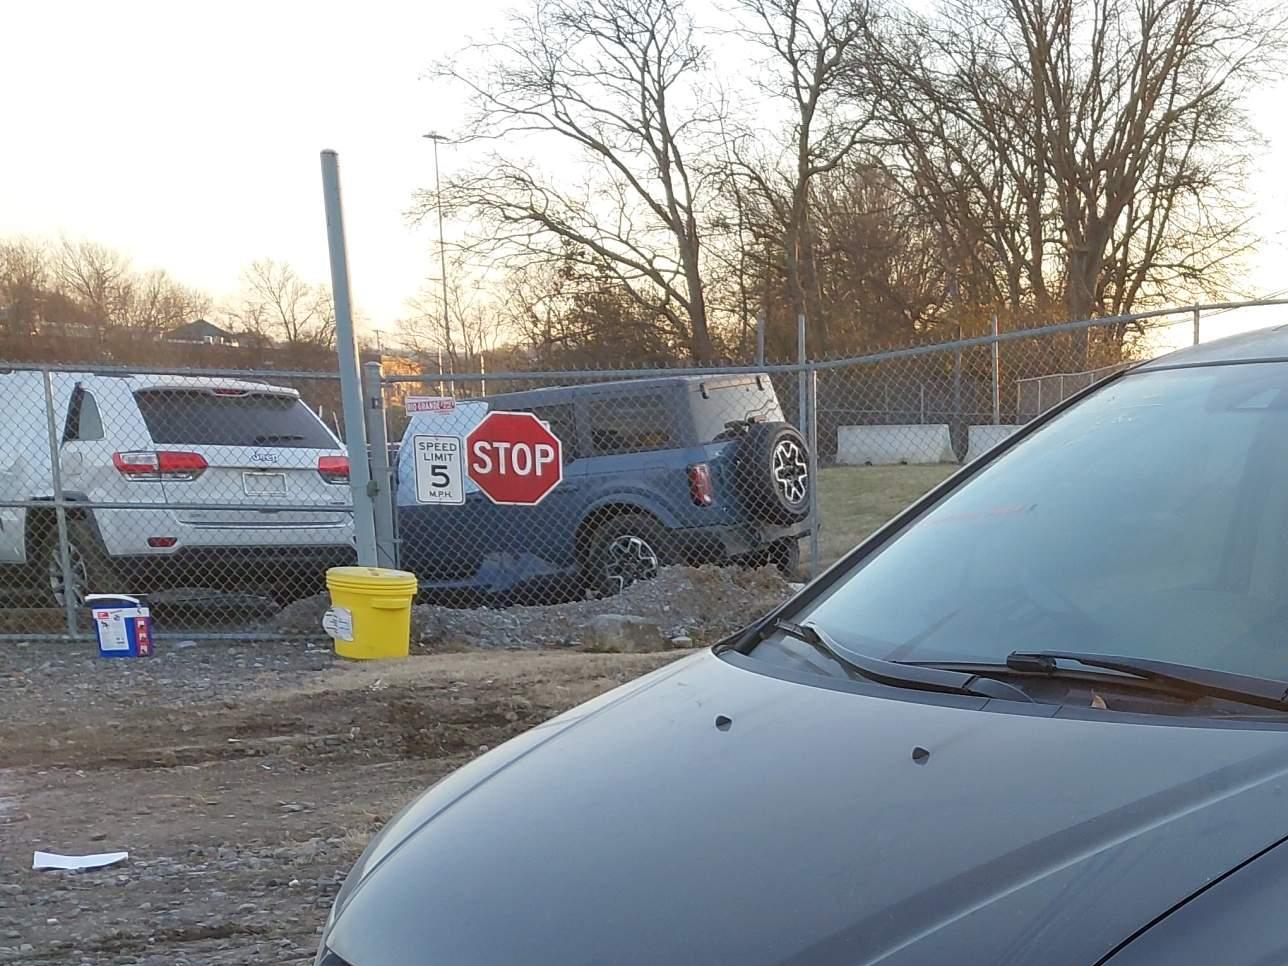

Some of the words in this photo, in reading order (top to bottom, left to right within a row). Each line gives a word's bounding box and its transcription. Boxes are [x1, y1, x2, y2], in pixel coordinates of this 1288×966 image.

[418, 442, 457, 452] SPEED
[423, 453, 455, 462] LIMIT
[472, 441, 555, 476] STOP
[431, 465, 450, 488] 5
